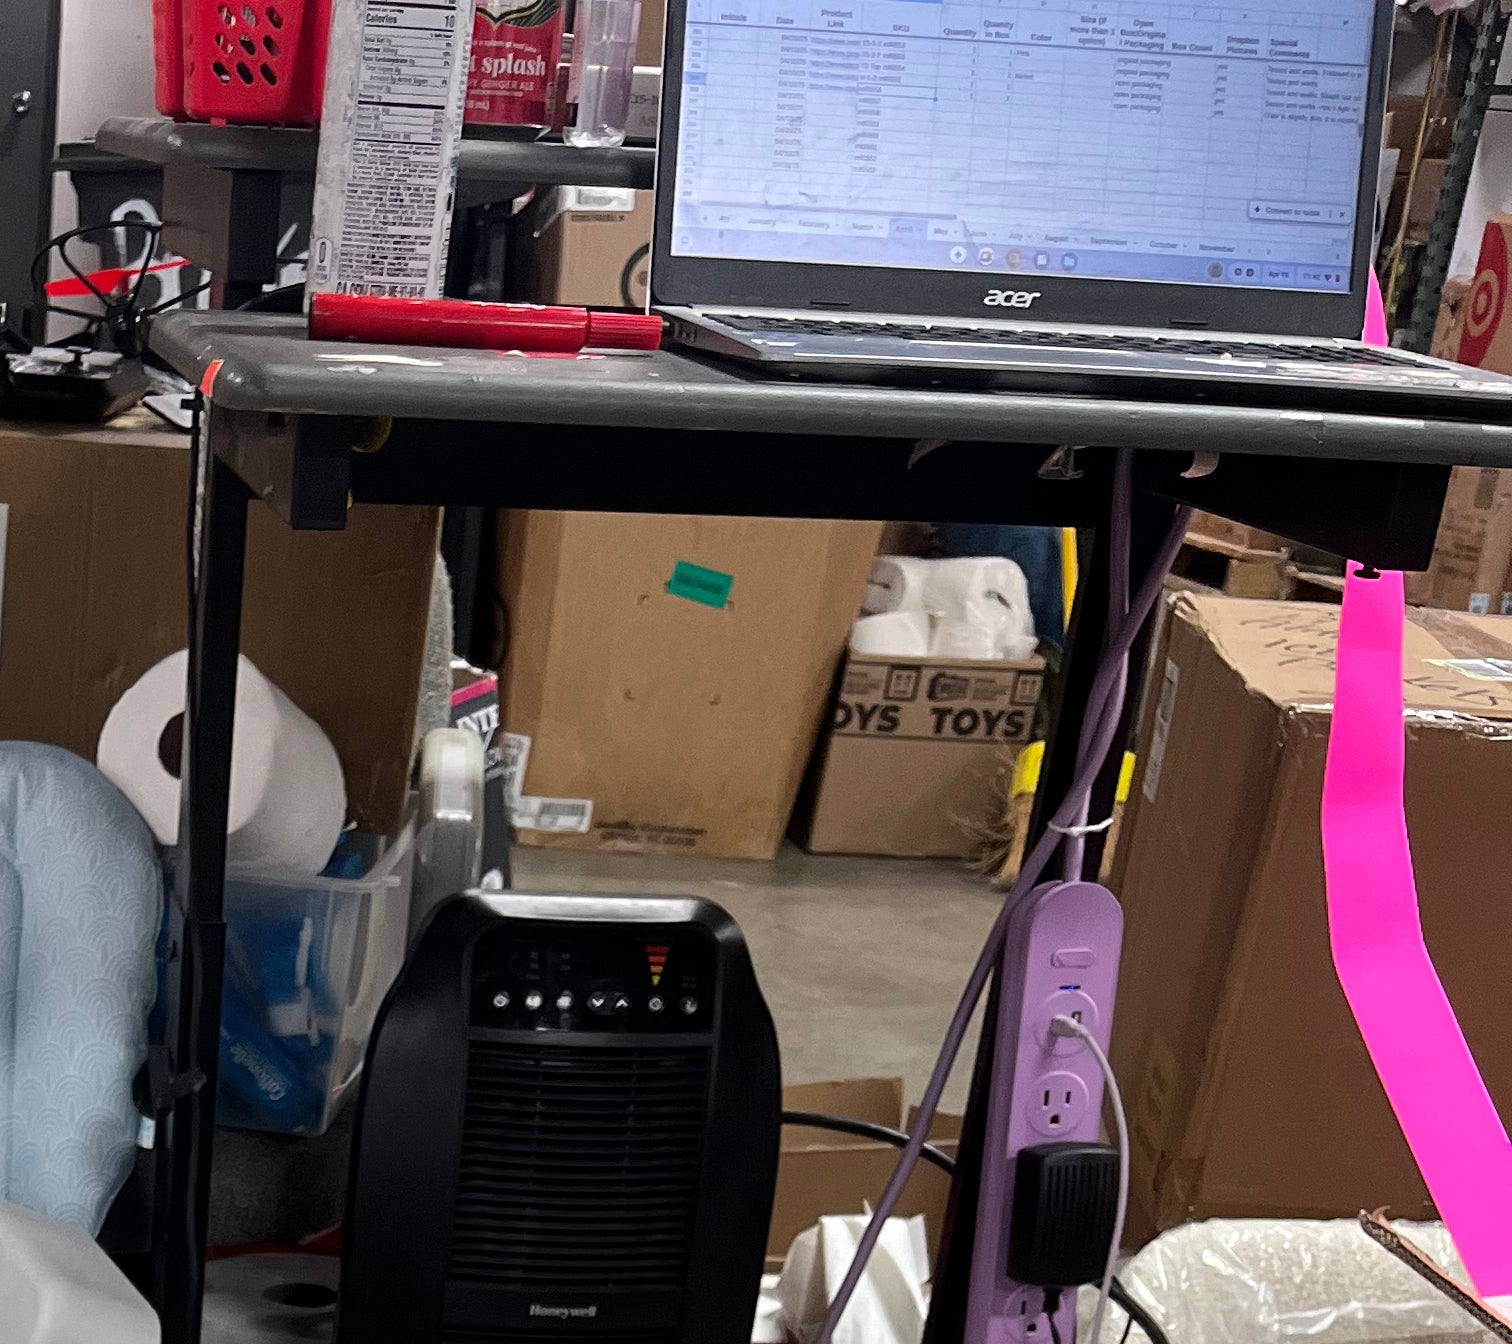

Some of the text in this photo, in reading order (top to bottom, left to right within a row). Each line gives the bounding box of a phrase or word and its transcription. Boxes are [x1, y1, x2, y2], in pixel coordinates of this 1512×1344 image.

[366, 13, 455, 28] Calories 10
[481, 54, 546, 77] splash
[520, 82, 535, 91] ALE
[984, 290, 1041, 308] acer
[833, 700, 901, 733] OYS
[929, 706, 1025, 737] TOYS
[529, 1305, 597, 1319] Honeywell
